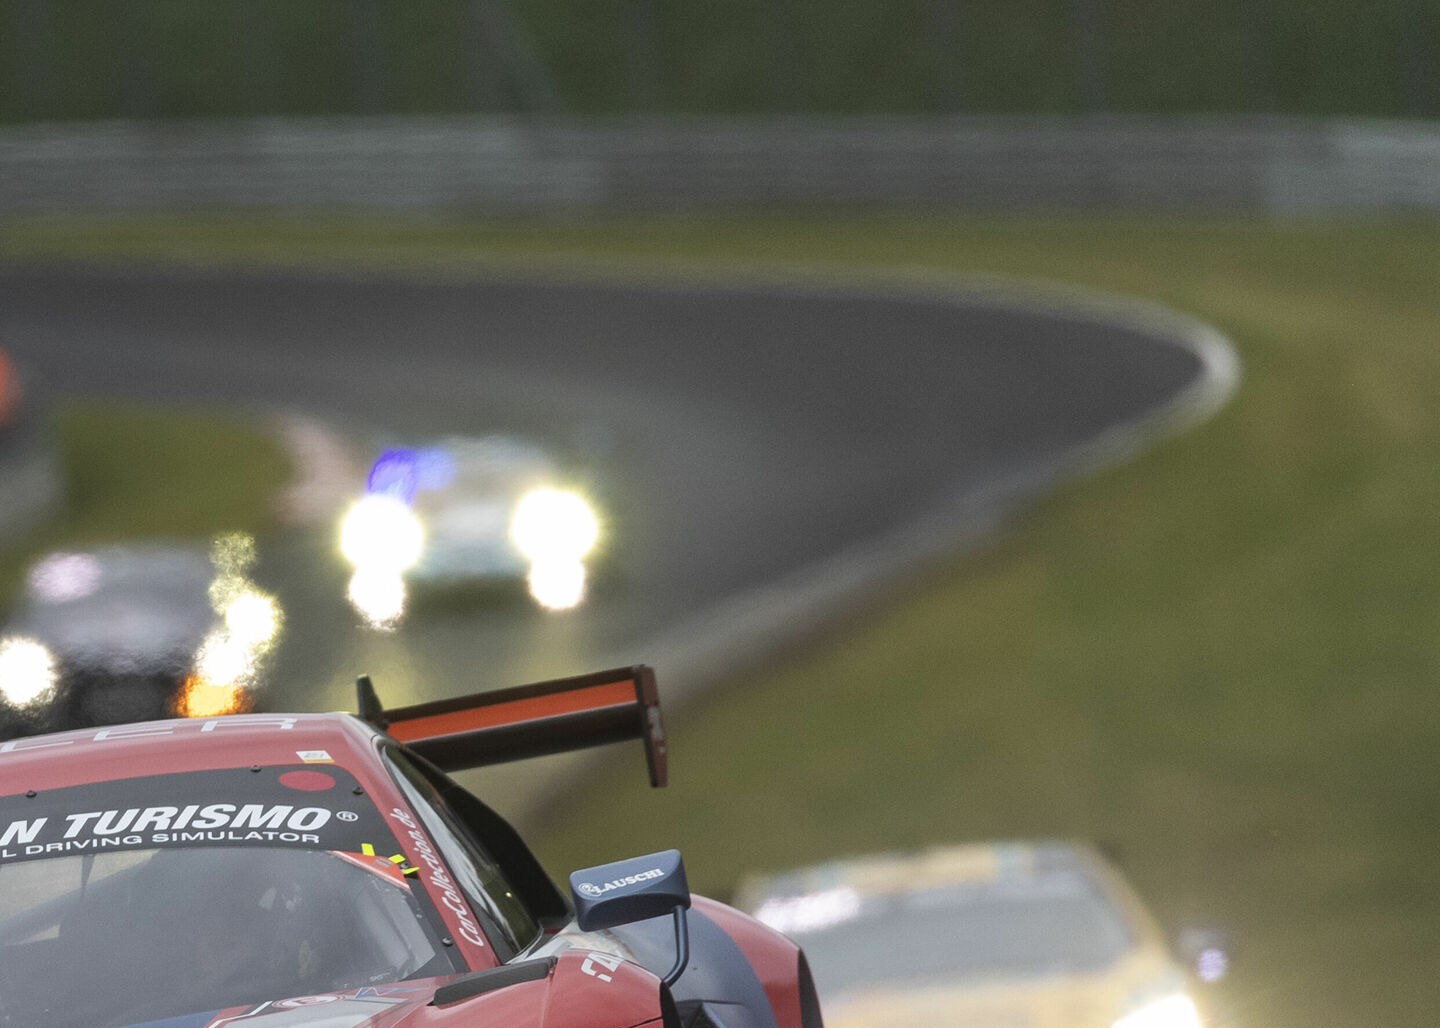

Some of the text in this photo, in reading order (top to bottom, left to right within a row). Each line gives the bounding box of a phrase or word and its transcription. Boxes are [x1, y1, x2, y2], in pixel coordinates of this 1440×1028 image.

[25, 834, 142, 854] DRIVING
[152, 831, 320, 843] SIMULATOR
[390, 808, 484, 947] CarCollection.de
[593, 868, 665, 894] LAUSCHI
